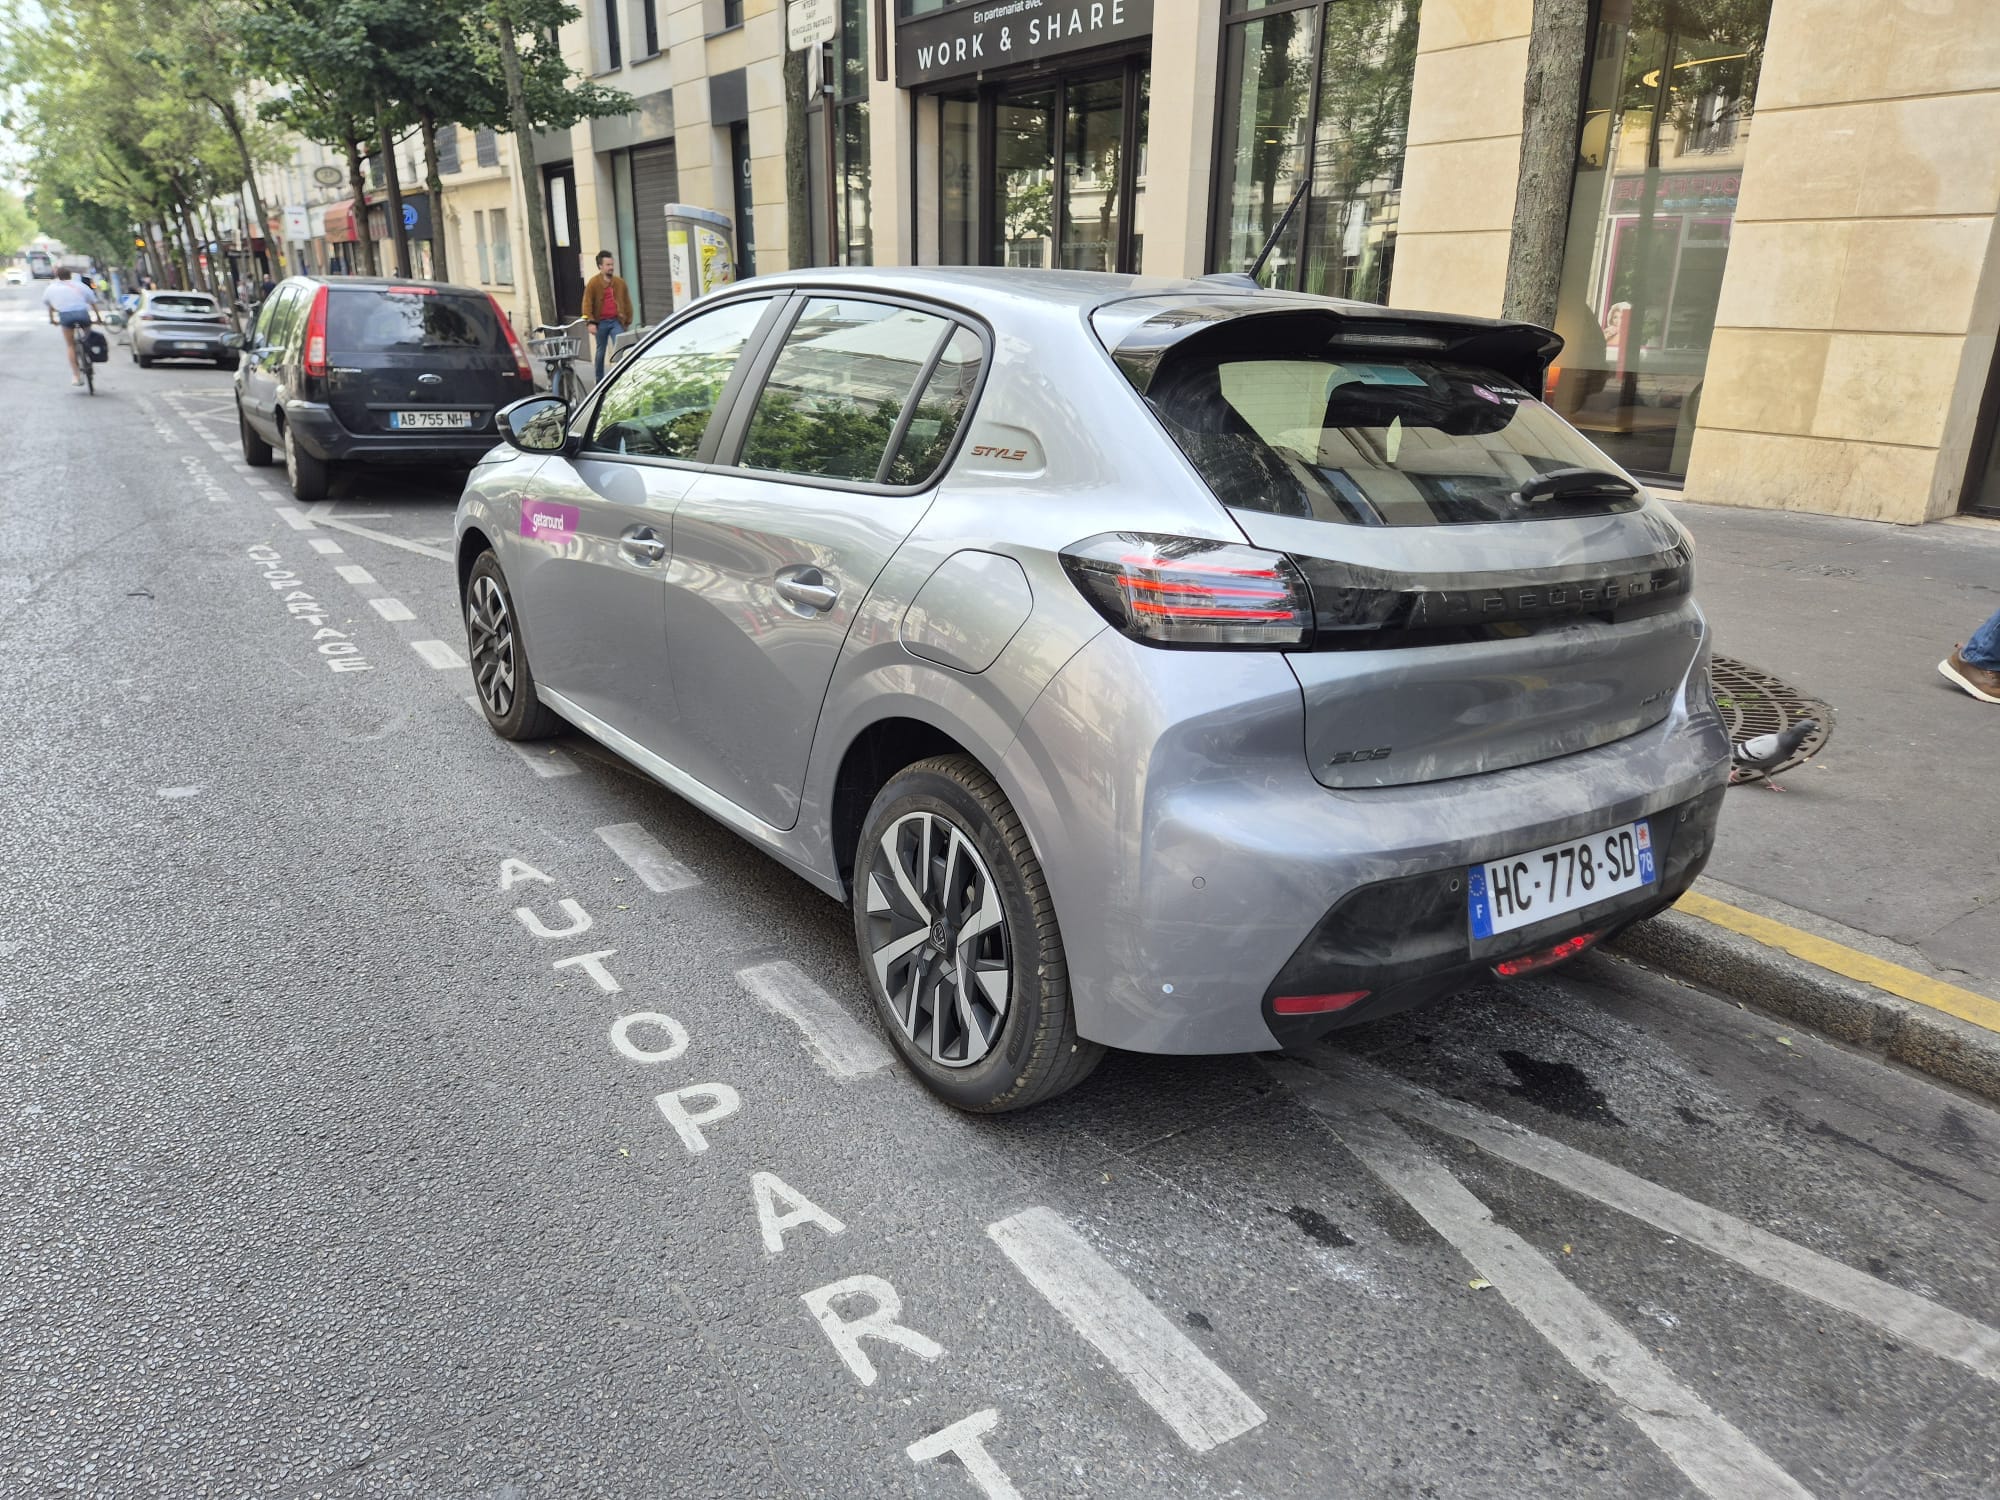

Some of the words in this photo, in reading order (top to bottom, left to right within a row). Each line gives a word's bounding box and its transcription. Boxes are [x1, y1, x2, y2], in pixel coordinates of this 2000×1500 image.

[973, 11, 984, 24] En
[984, 2, 1024, 22] partenariat
[918, 33, 984, 71] WORK
[1000, 27, 1012, 51] &
[1030, 0, 1125, 45] SHARE
[970, 446, 1028, 460] STYLE
[532, 512, 564, 532] getaround
[1483, 578, 1661, 613] PEUGEOT
[1639, 853, 1654, 873] 78
[1491, 831, 1637, 918] HC-778-SD
[1476, 903, 1483, 919] F
[498, 856, 1024, 1500] AUTOPART
